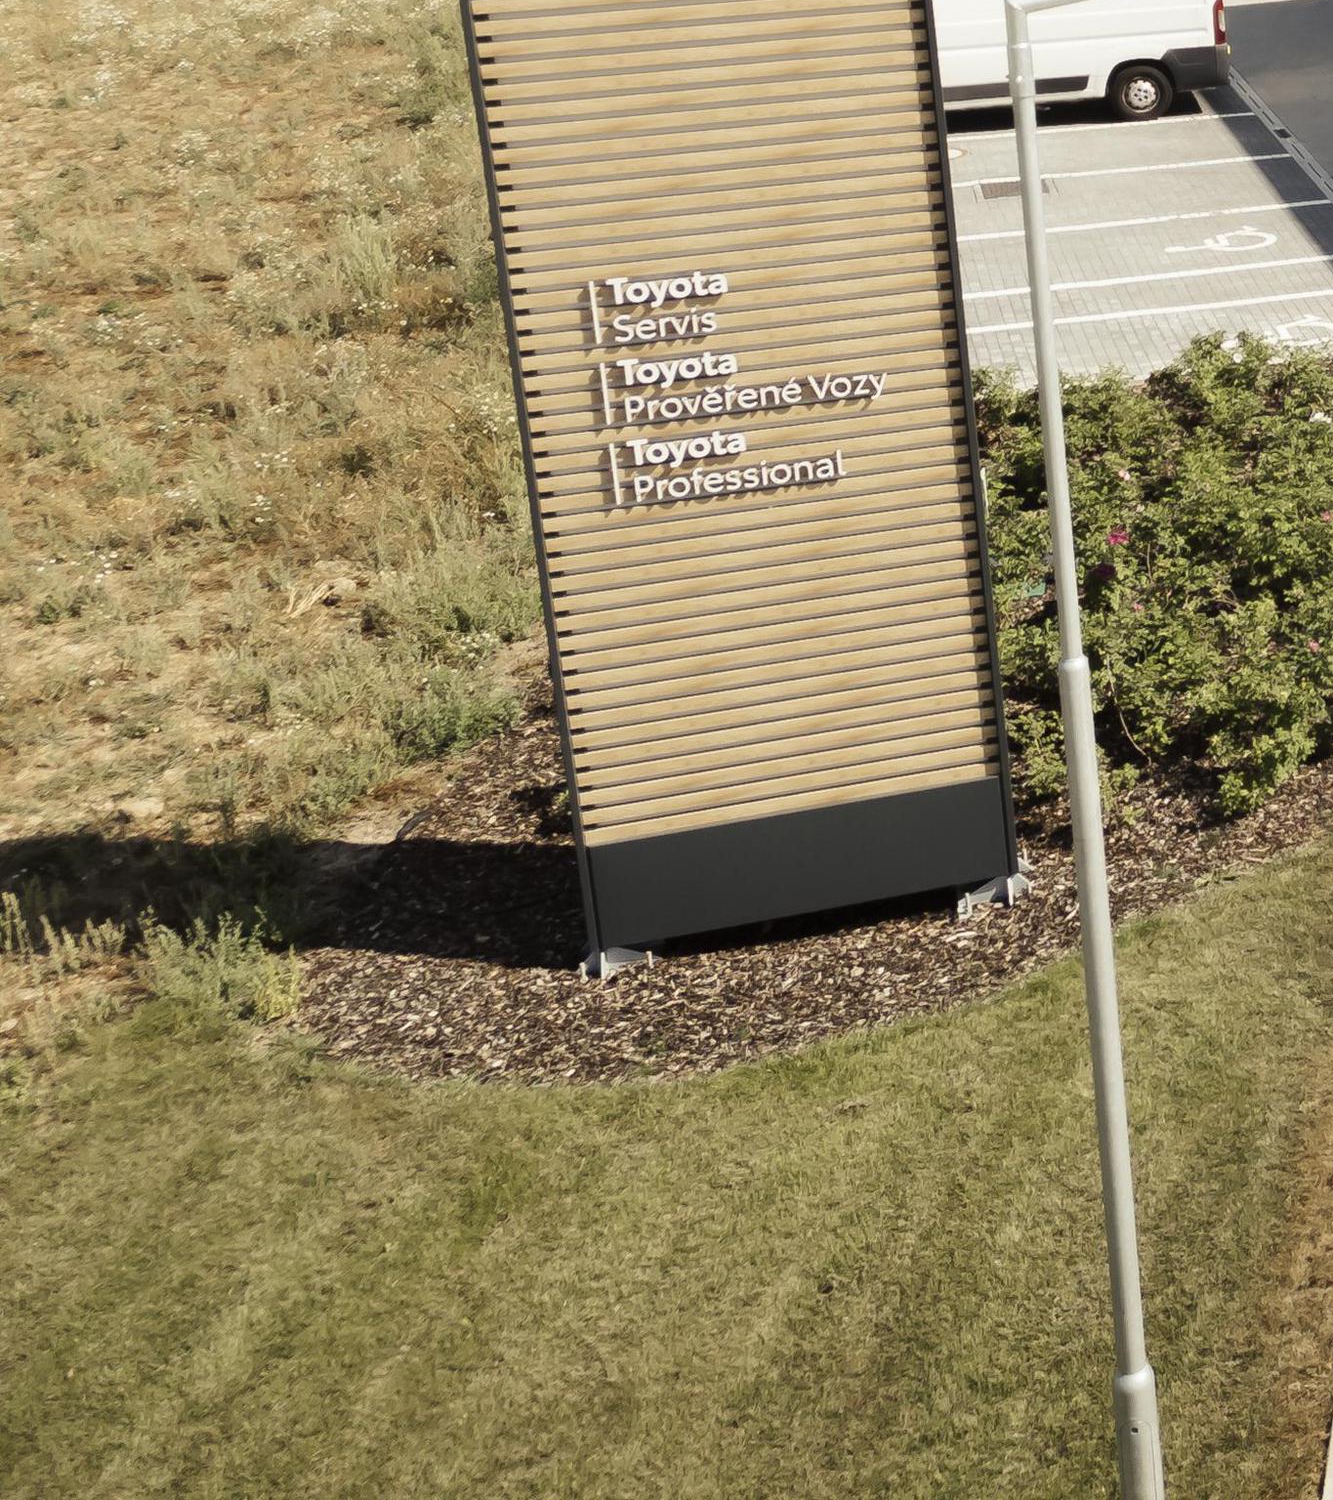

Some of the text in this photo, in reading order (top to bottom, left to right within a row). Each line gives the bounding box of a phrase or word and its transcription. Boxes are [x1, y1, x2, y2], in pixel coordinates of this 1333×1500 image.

[605, 271, 729, 308] Toyota
[612, 308, 717, 342] Servis
[616, 351, 738, 388] Toyota
[624, 372, 888, 423] Prověřené Vozy
[626, 431, 747, 468] Toyota
[634, 449, 847, 502] Professional
